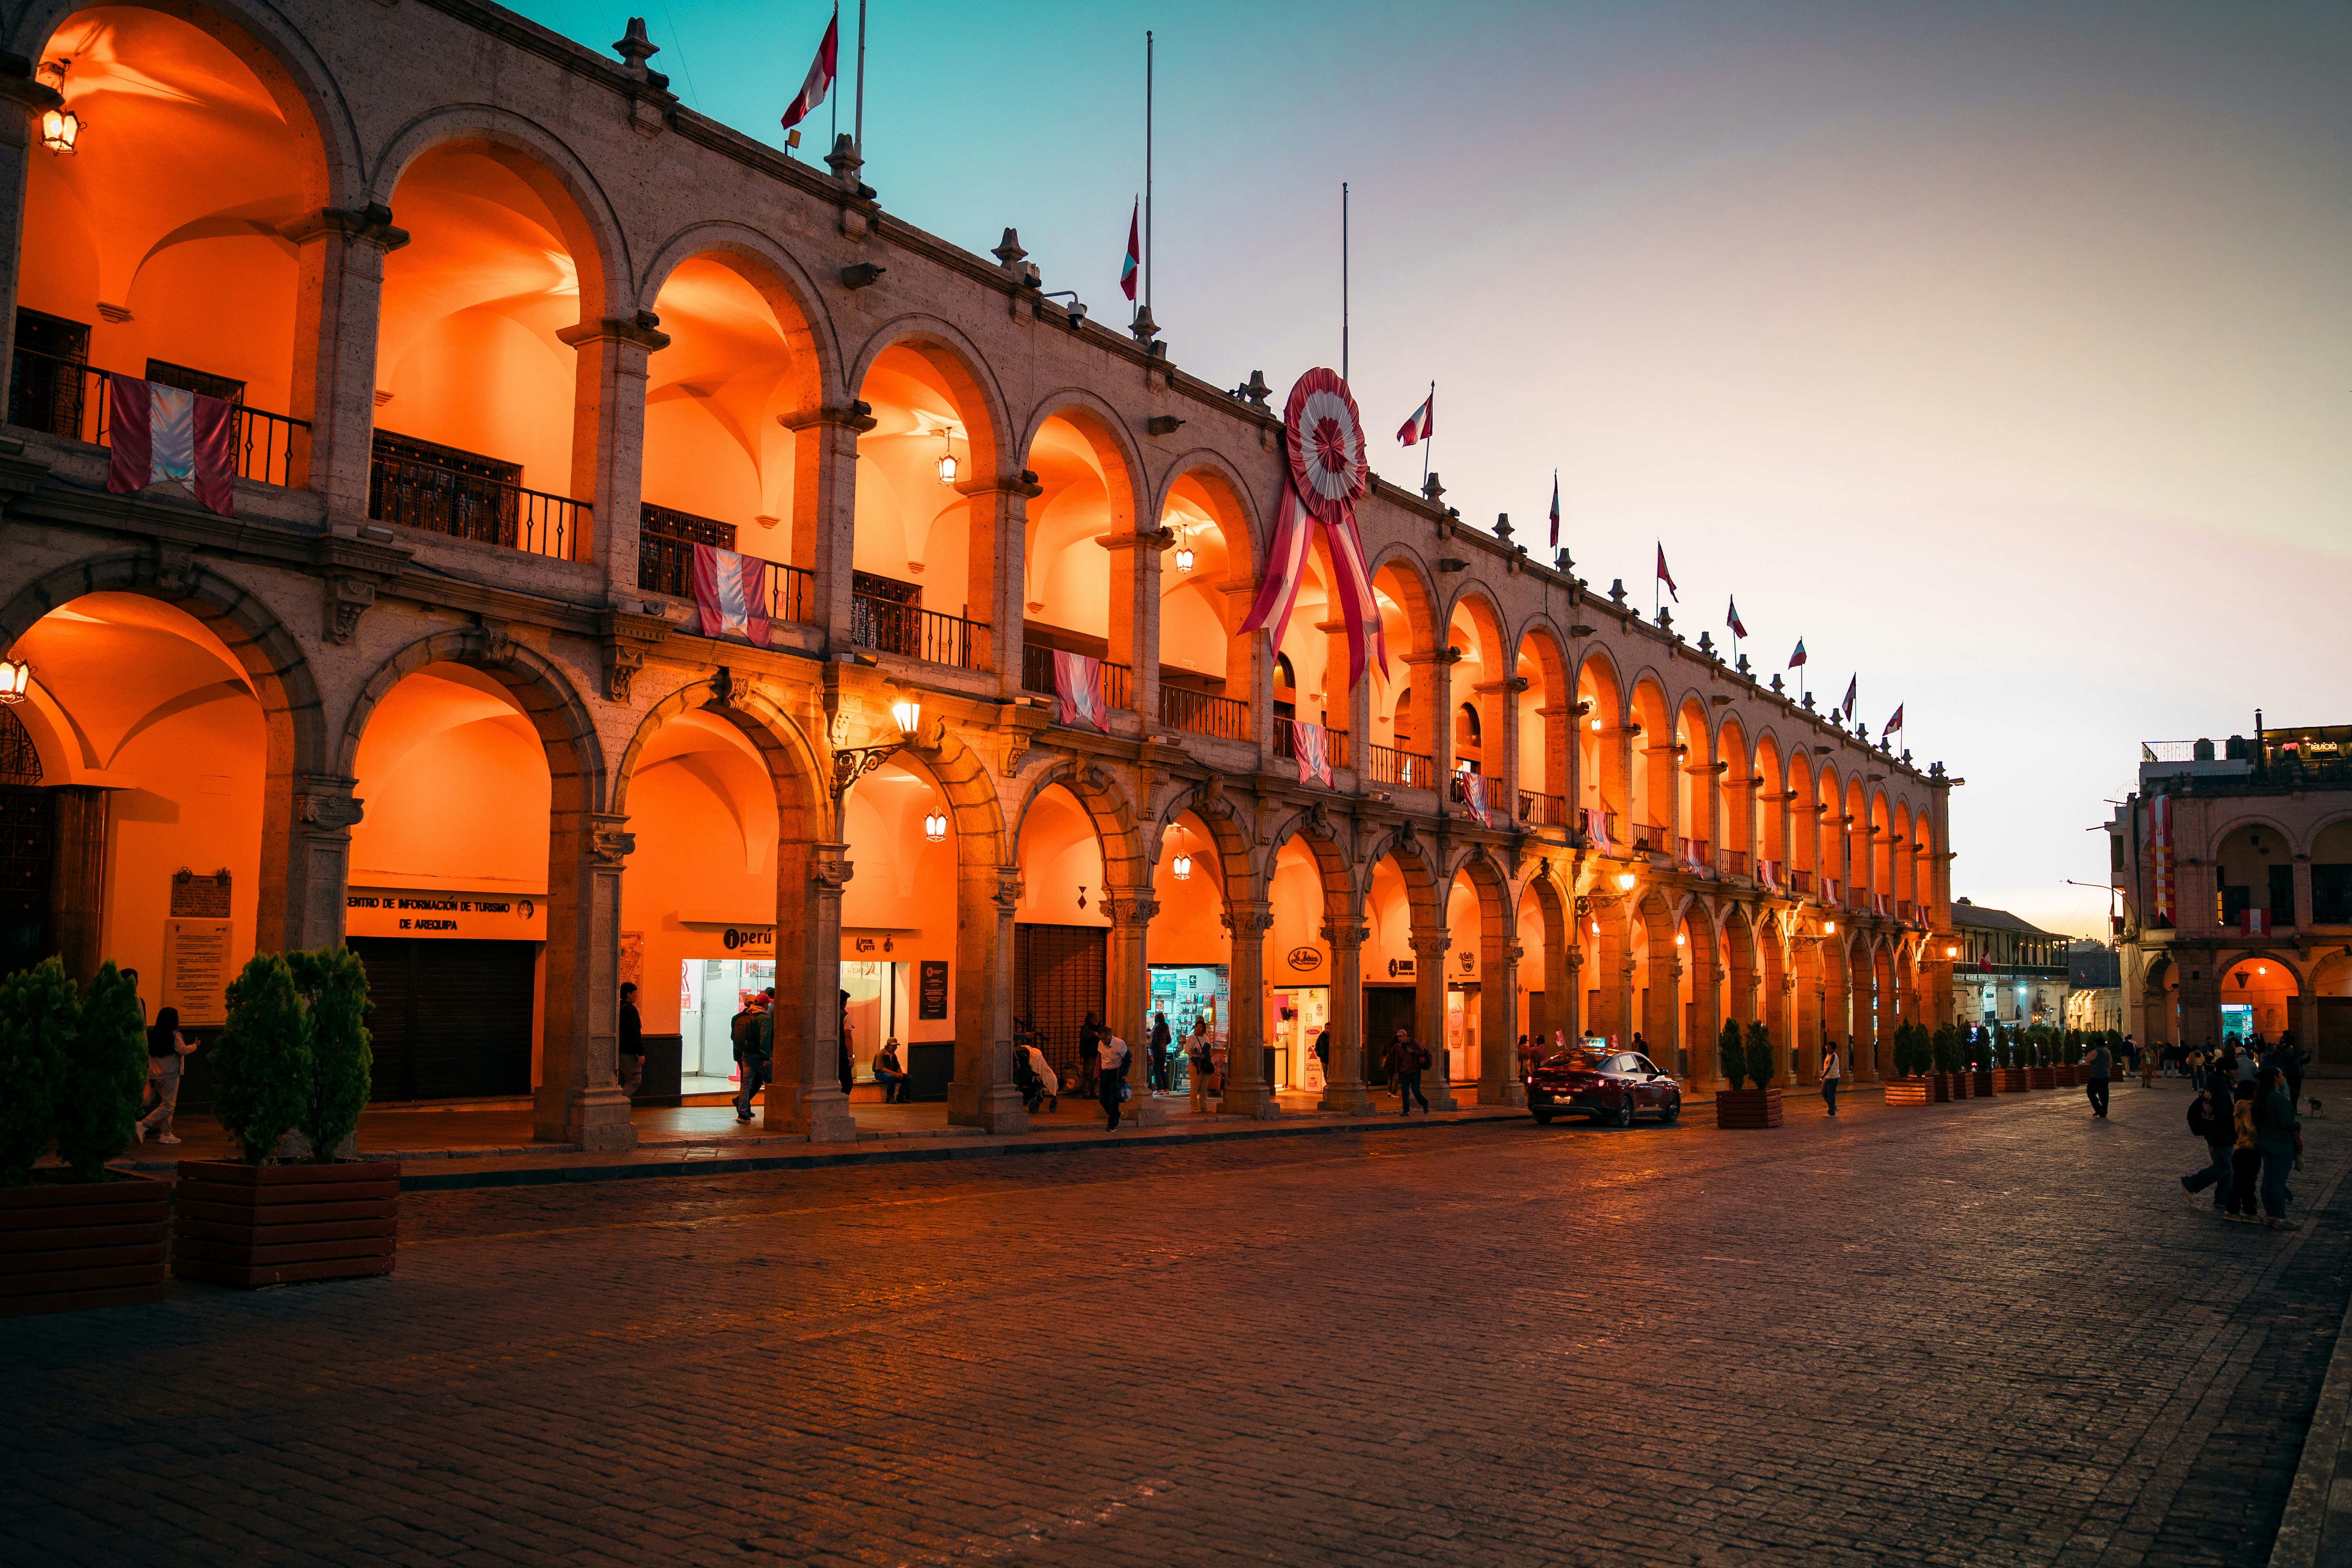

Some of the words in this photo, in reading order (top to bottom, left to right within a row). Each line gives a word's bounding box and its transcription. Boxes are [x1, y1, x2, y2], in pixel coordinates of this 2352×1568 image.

[383, 898, 395, 909] DE
[398, 895, 458, 911] INFORMACIÓN
[461, 902, 472, 911] DE
[474, 902, 510, 913] TURISMO
[399, 919, 412, 929] DE
[414, 919, 457, 930] AREQUIPA
